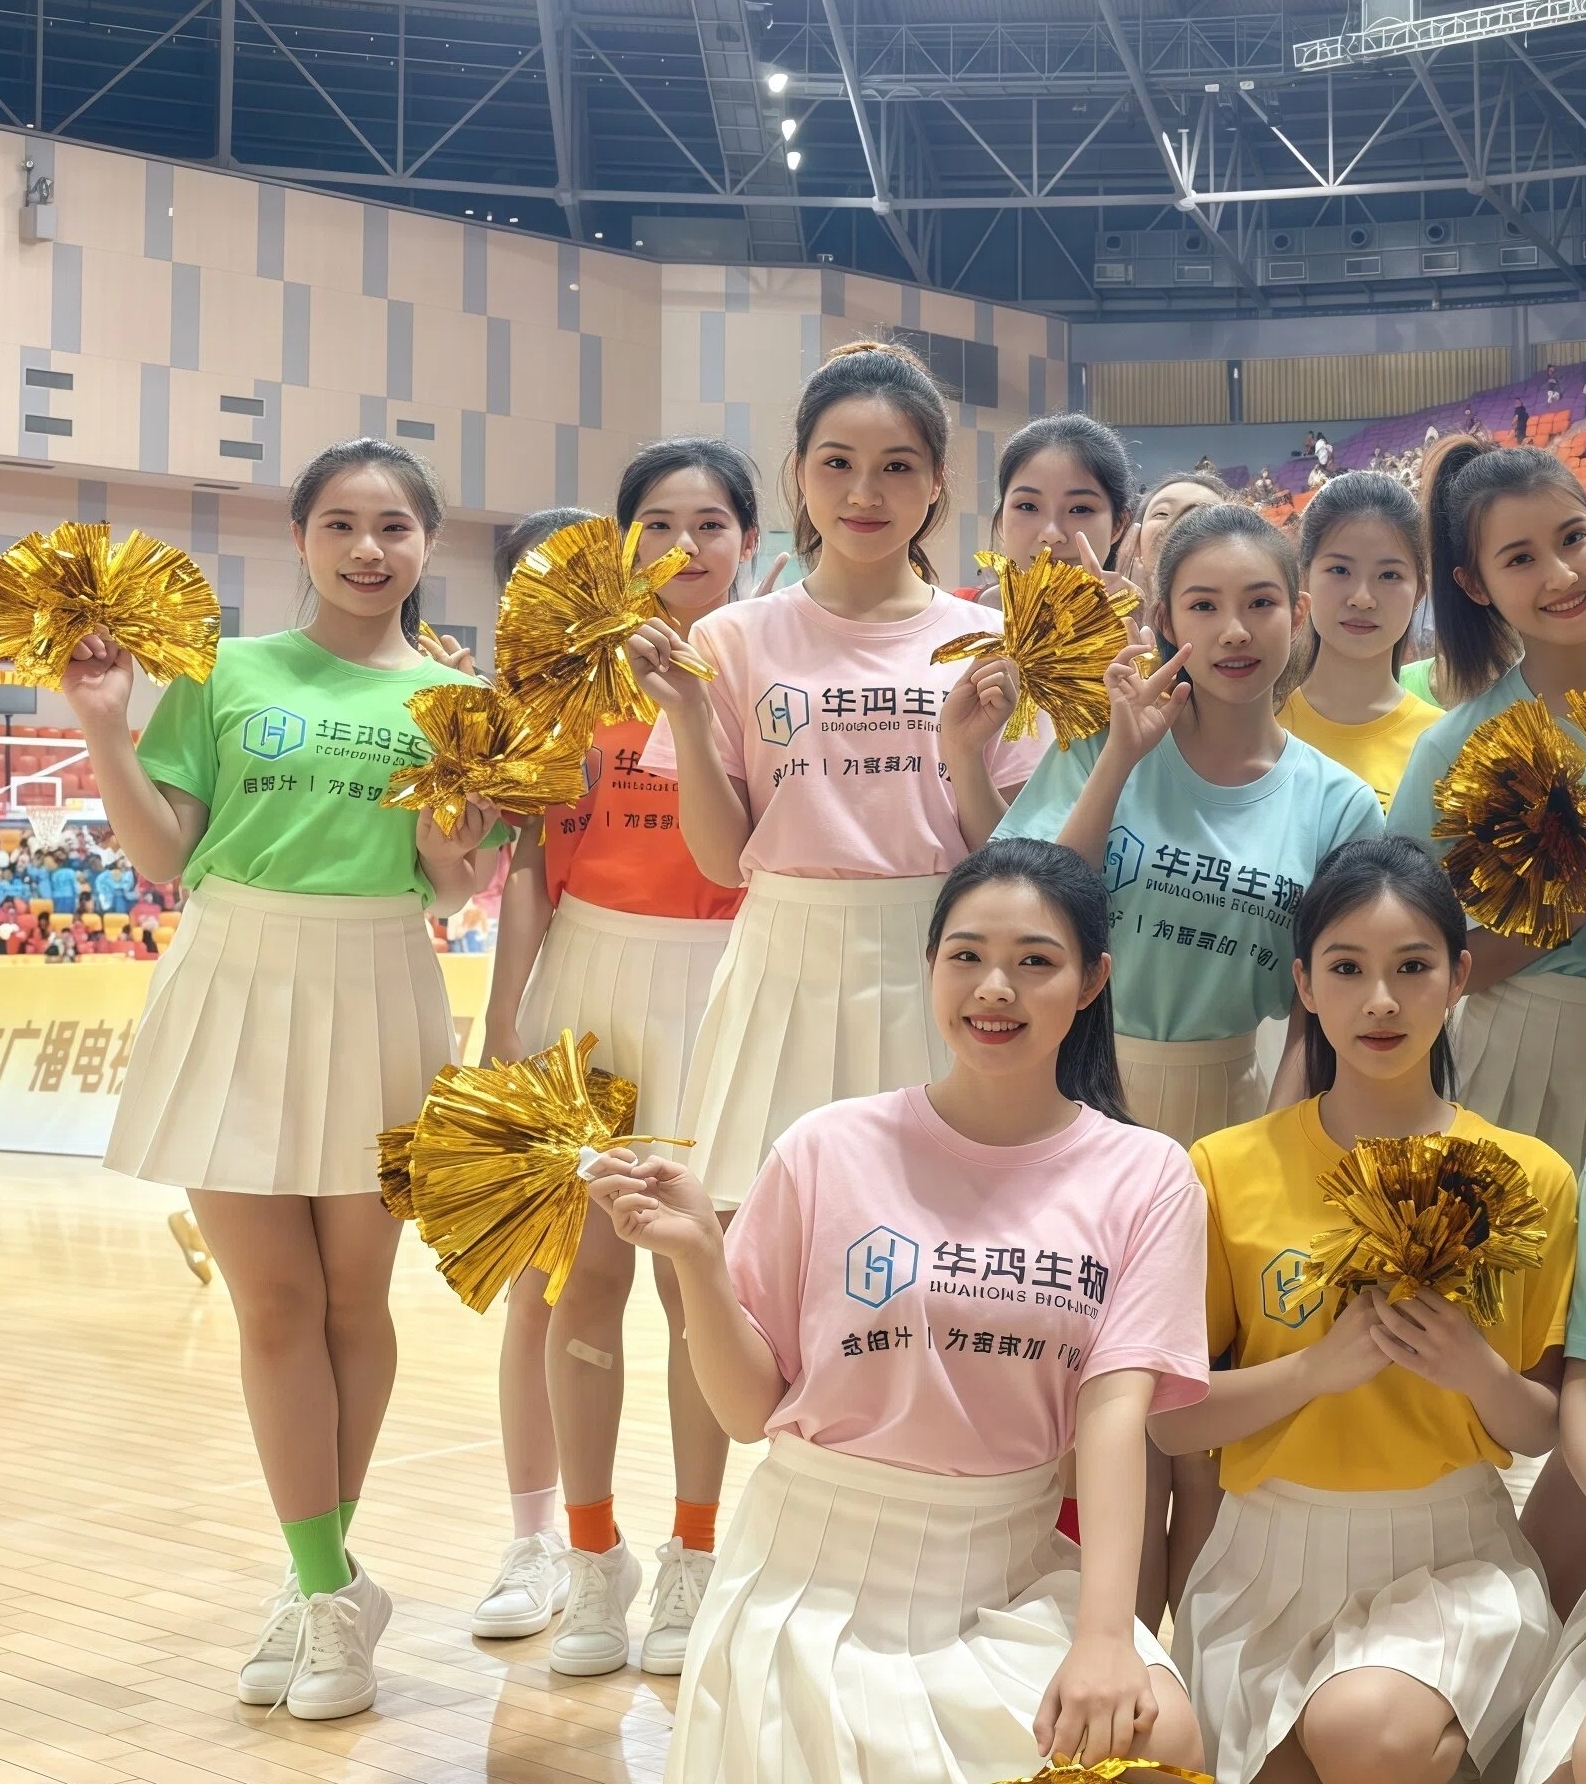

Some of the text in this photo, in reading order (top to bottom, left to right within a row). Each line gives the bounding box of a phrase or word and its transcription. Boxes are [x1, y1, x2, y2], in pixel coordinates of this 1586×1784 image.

[821, 687, 951, 717] 华鸿生
[0, 1018, 136, 1095] 广播电
[932, 1240, 1110, 1305] 华鸿生物
